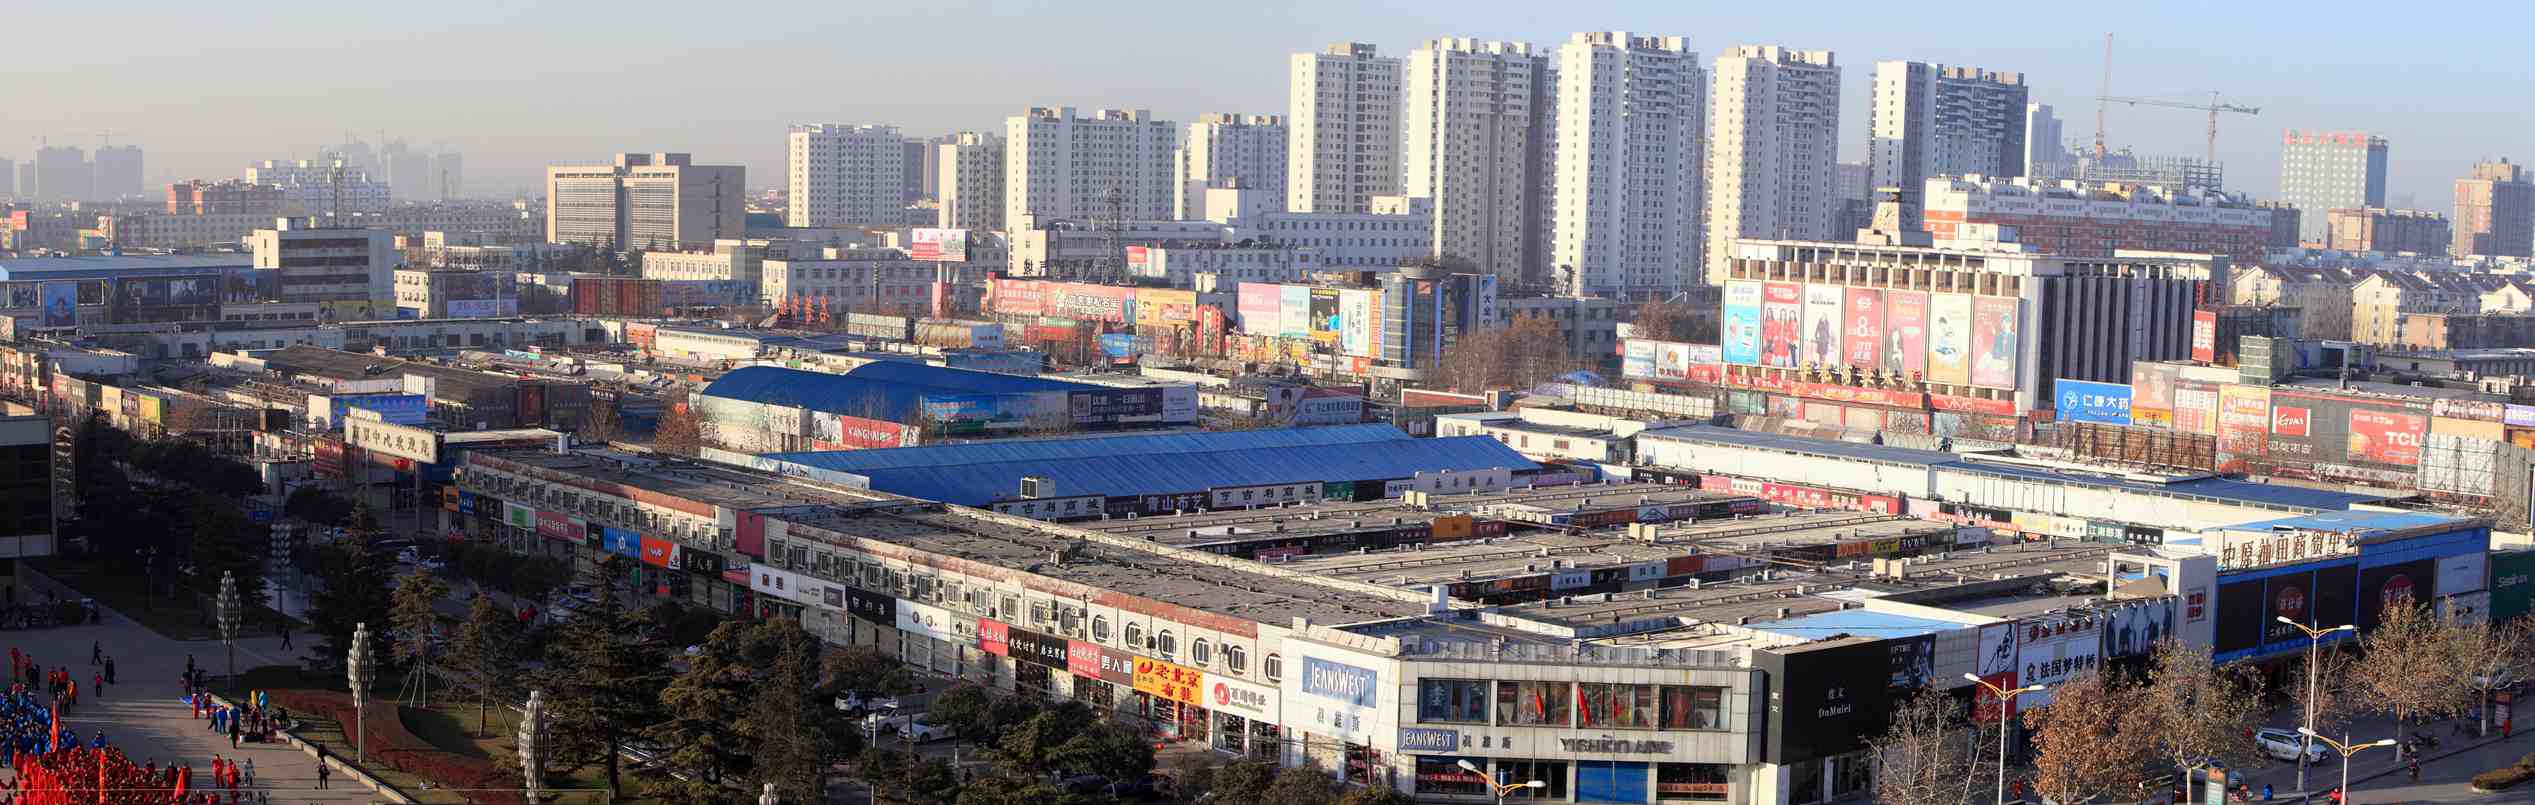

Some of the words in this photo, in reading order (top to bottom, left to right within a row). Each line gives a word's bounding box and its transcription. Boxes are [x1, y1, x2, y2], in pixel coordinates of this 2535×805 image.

[1154, 663, 1201, 688] 老北京
[1310, 662, 1367, 697] JEANSWEST
[1160, 682, 1194, 703] 布鞋
[1402, 728, 1453, 748] JEANSWEST
